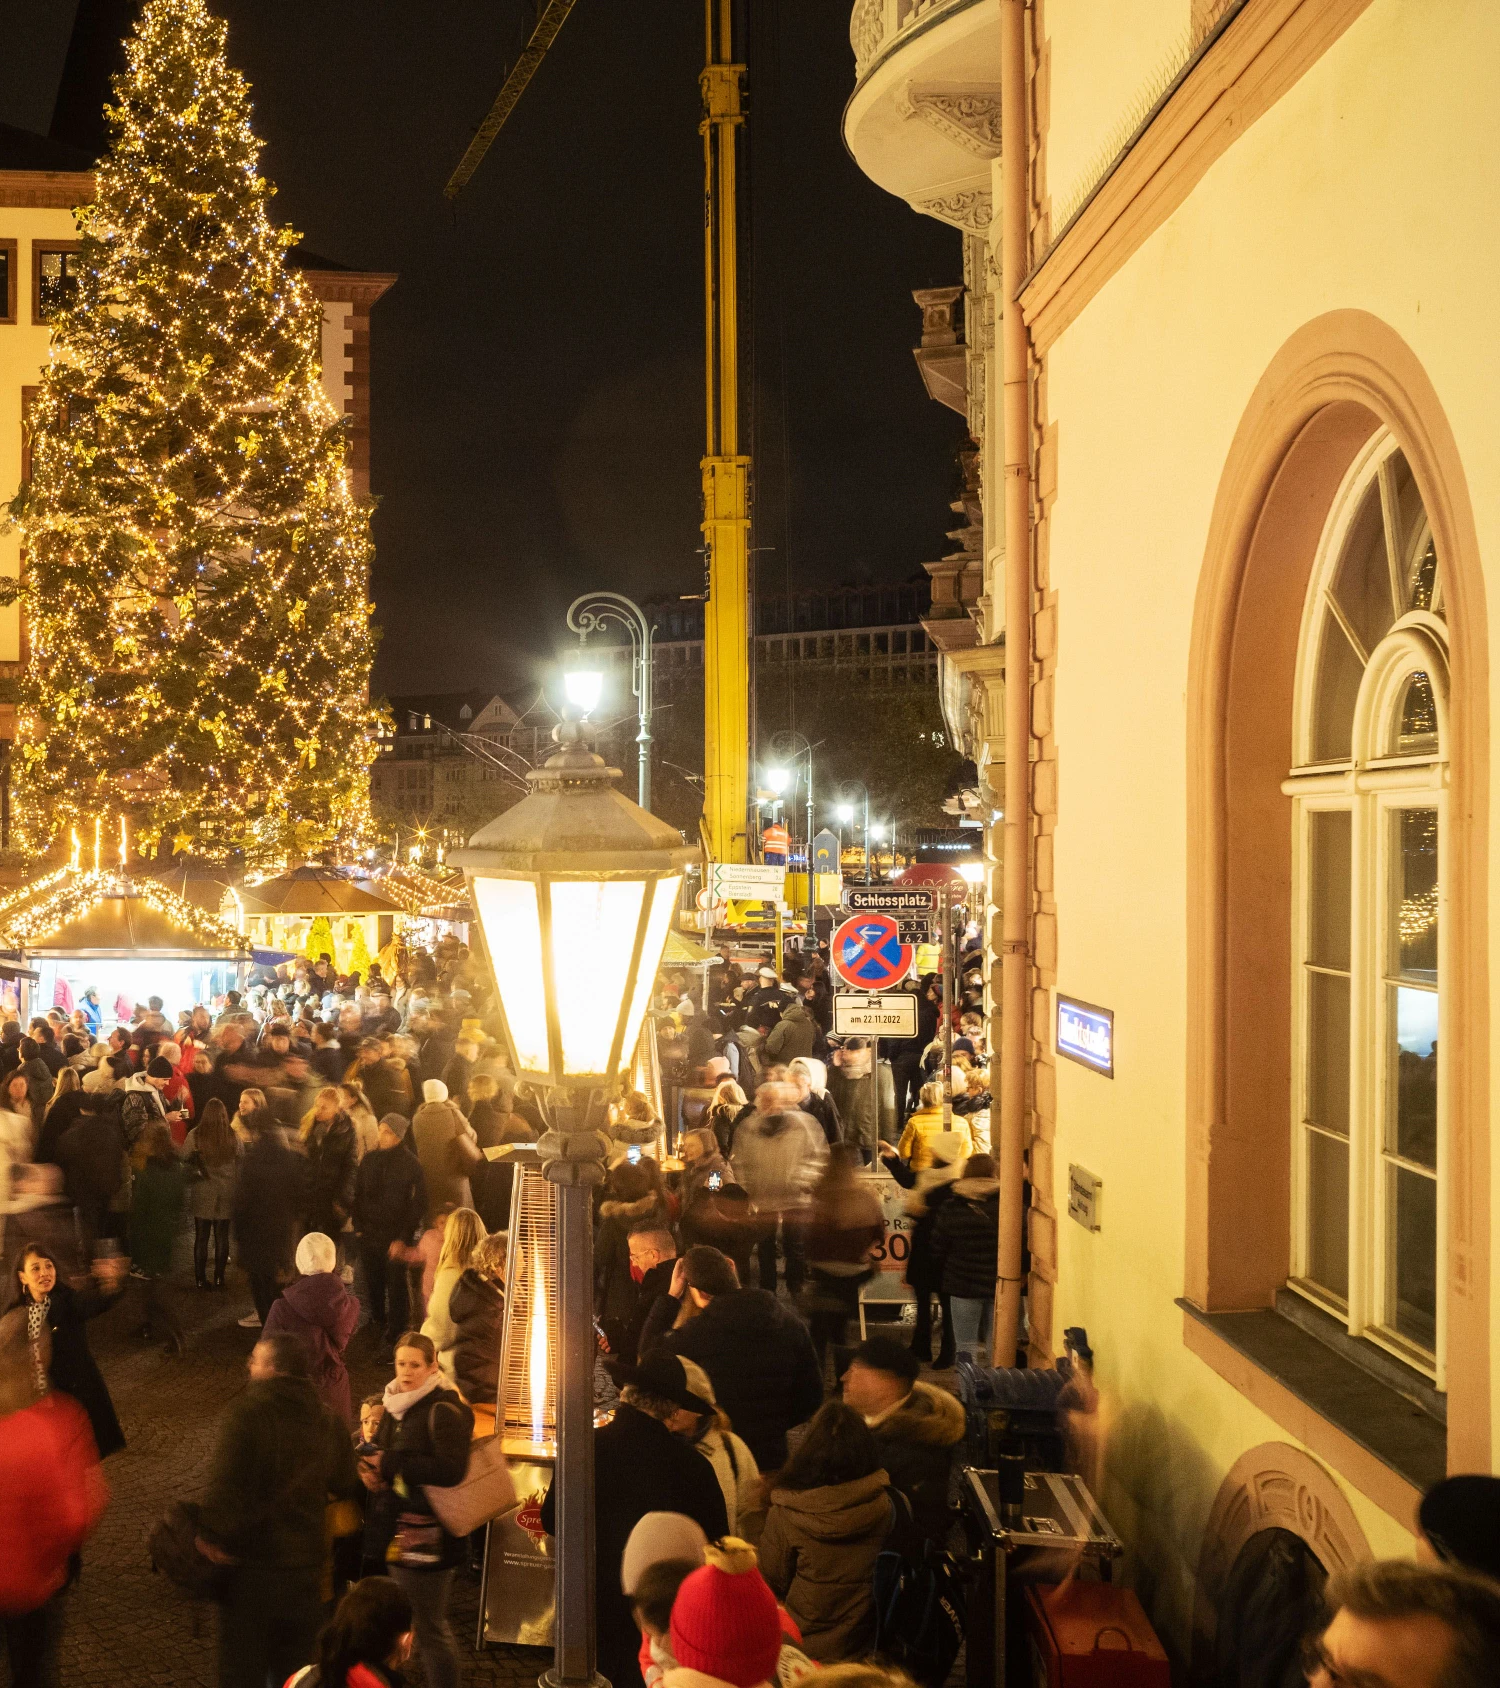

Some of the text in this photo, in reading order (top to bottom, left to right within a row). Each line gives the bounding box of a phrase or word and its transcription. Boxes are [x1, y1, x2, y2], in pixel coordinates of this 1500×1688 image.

[854, 894, 927, 909] Schlossplatz
[899, 921, 927, 931] 5.3.1
[905, 933, 923, 943] 6.2
[863, 1015, 901, 1023] 22.11.2022
[520, 1514, 541, 1526] Spre
